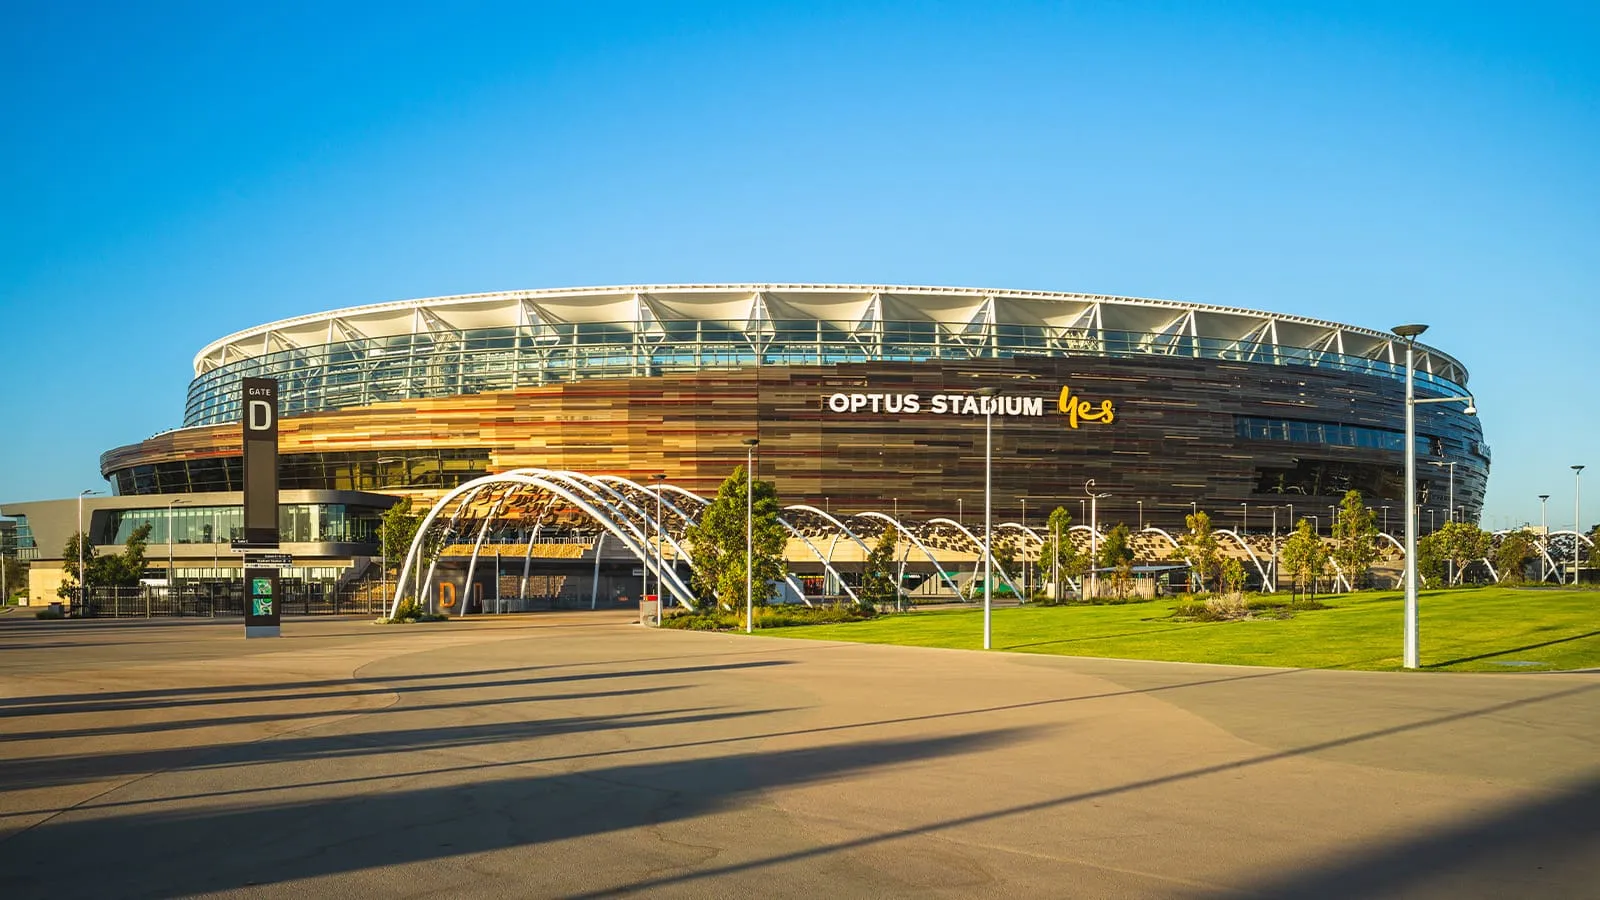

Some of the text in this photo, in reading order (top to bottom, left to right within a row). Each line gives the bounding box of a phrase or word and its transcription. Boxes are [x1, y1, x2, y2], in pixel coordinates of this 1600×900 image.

[249, 387, 272, 396] GATE
[249, 400, 272, 431] D
[829, 393, 1043, 416] OPTUS STADIUM
[439, 582, 457, 608] D
